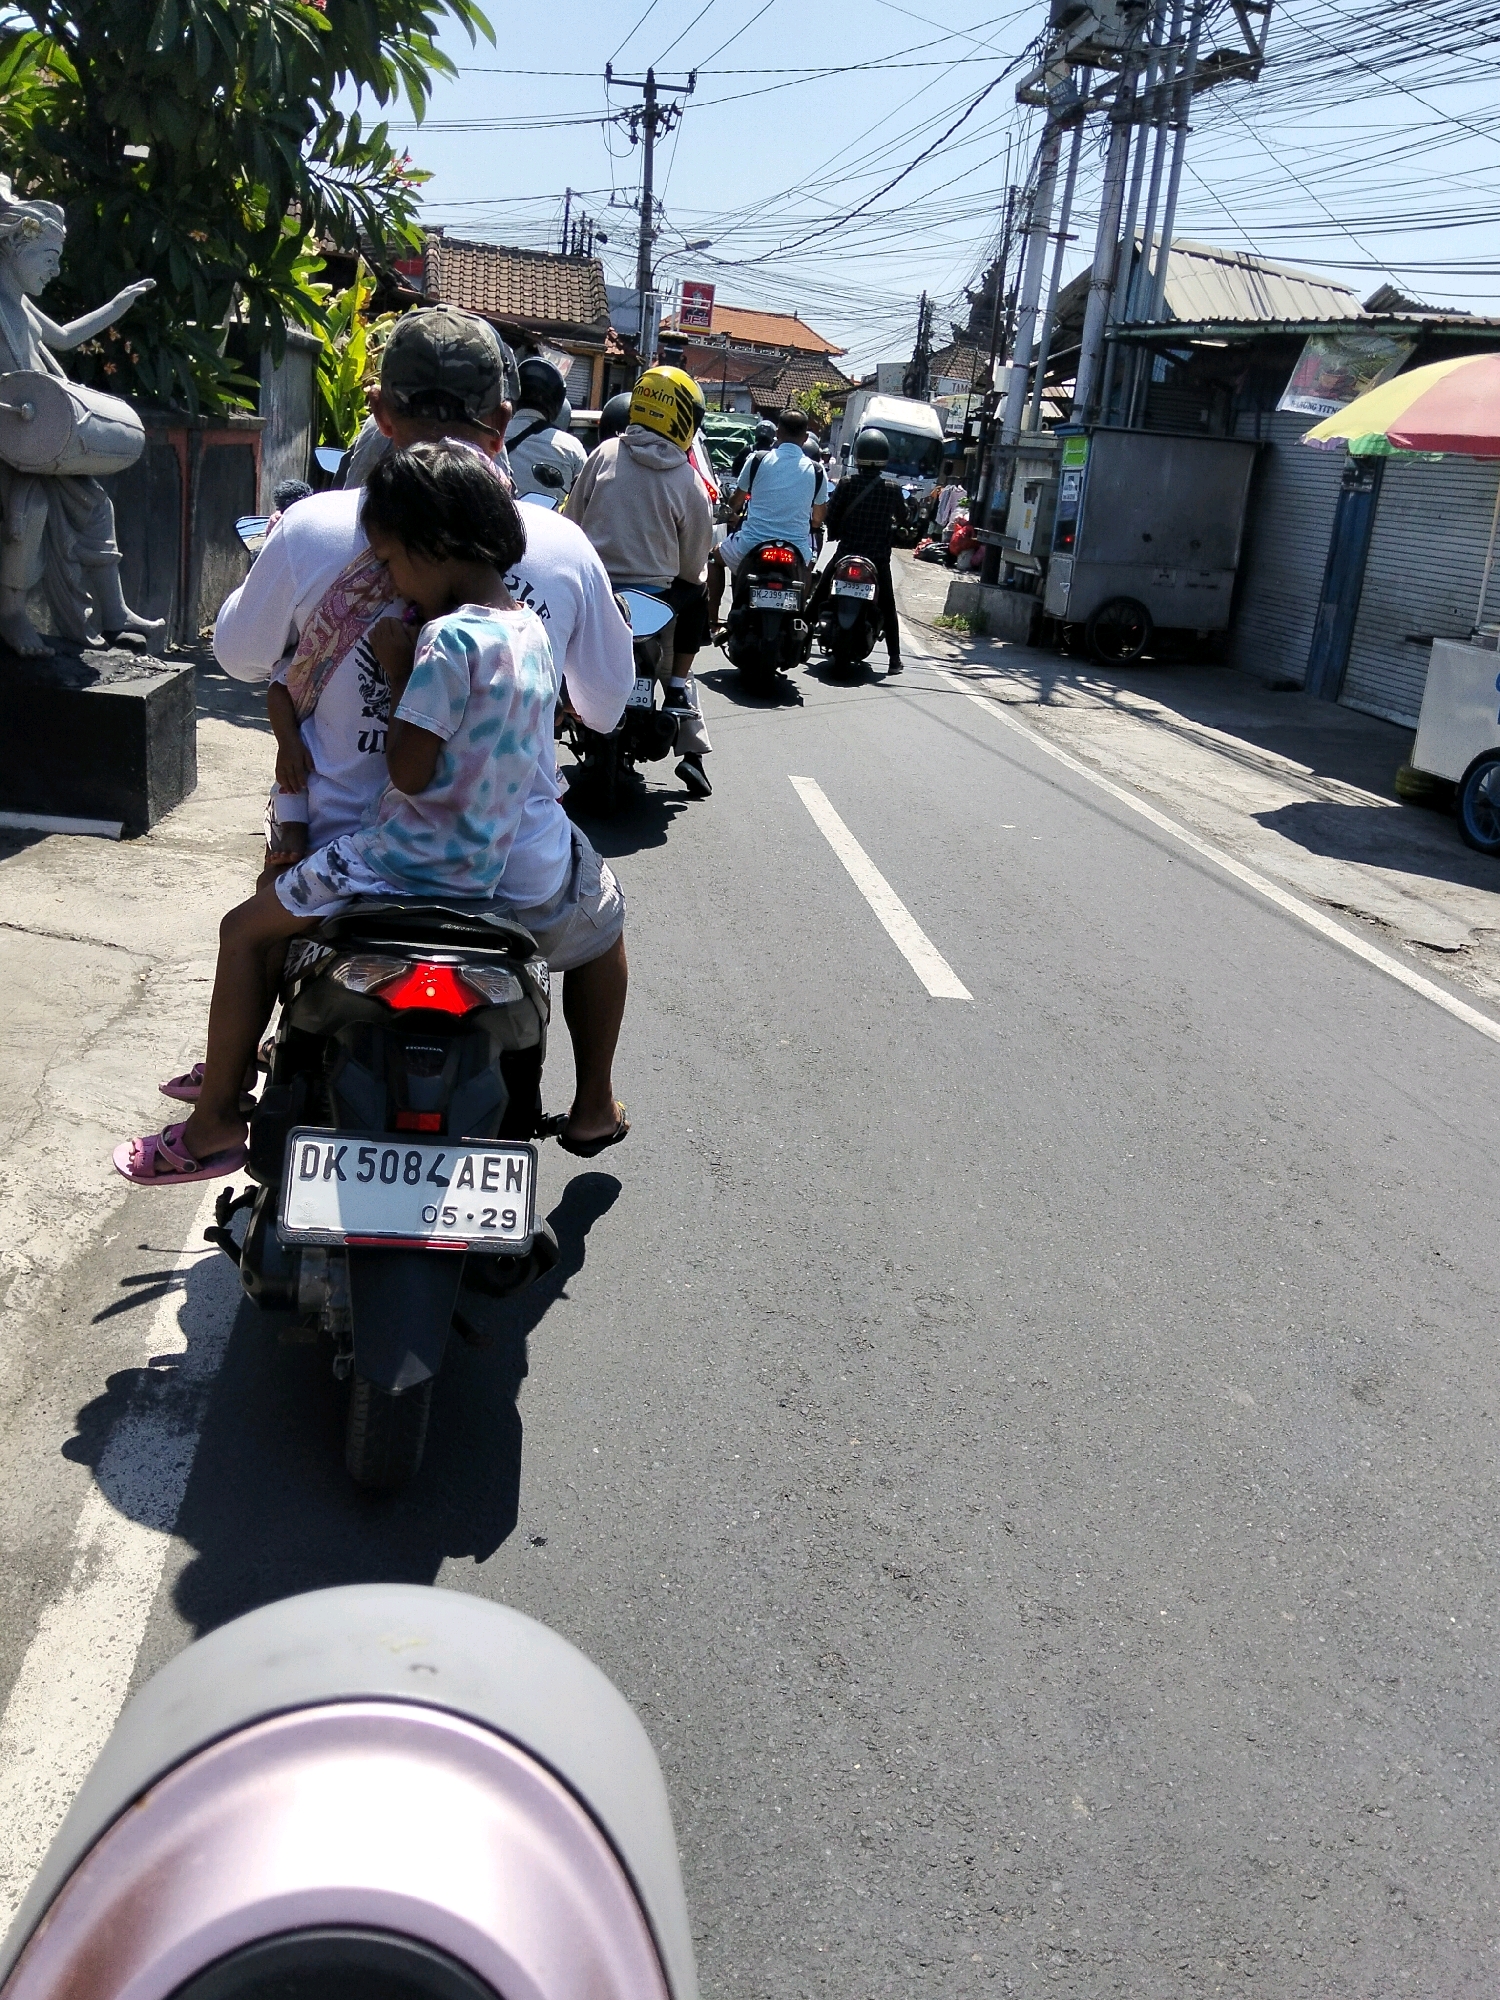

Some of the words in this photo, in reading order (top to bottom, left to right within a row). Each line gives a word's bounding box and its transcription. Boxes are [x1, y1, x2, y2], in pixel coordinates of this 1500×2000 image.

[633, 385, 674, 406] maxim
[300, 1144, 348, 1181] DK
[356, 1146, 450, 1187] 5084
[457, 1155, 523, 1193] AEN
